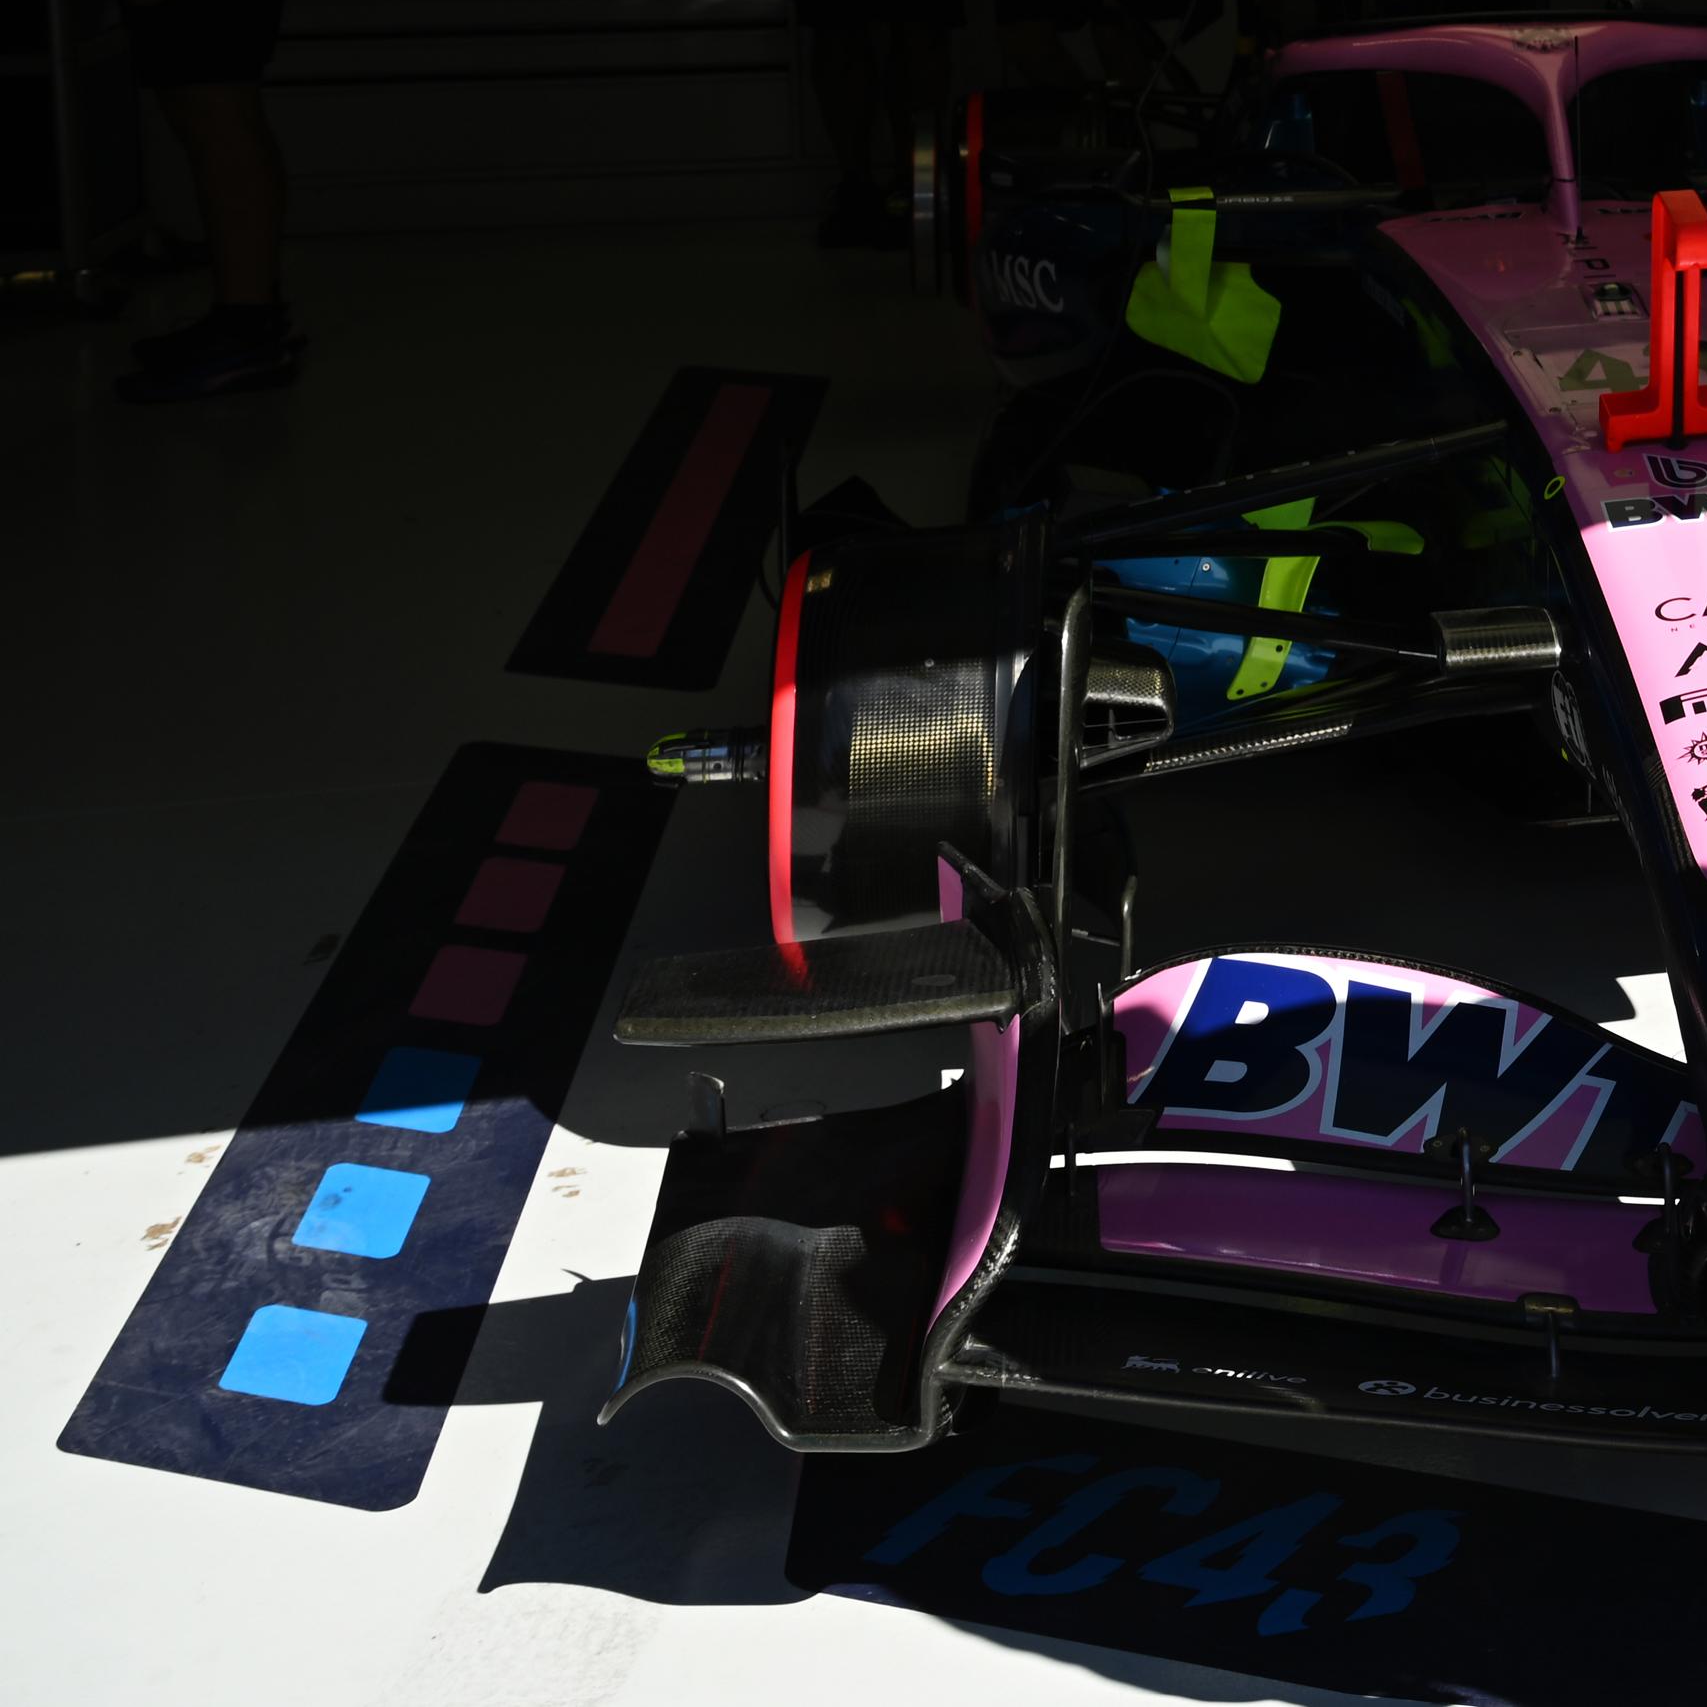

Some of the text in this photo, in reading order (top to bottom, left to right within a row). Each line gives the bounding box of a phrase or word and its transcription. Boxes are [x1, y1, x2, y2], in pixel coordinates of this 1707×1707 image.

[983, 250, 1065, 314] MSC
[1192, 1366, 1308, 1383] enilive
[861, 1453, 1466, 1637] FC43
